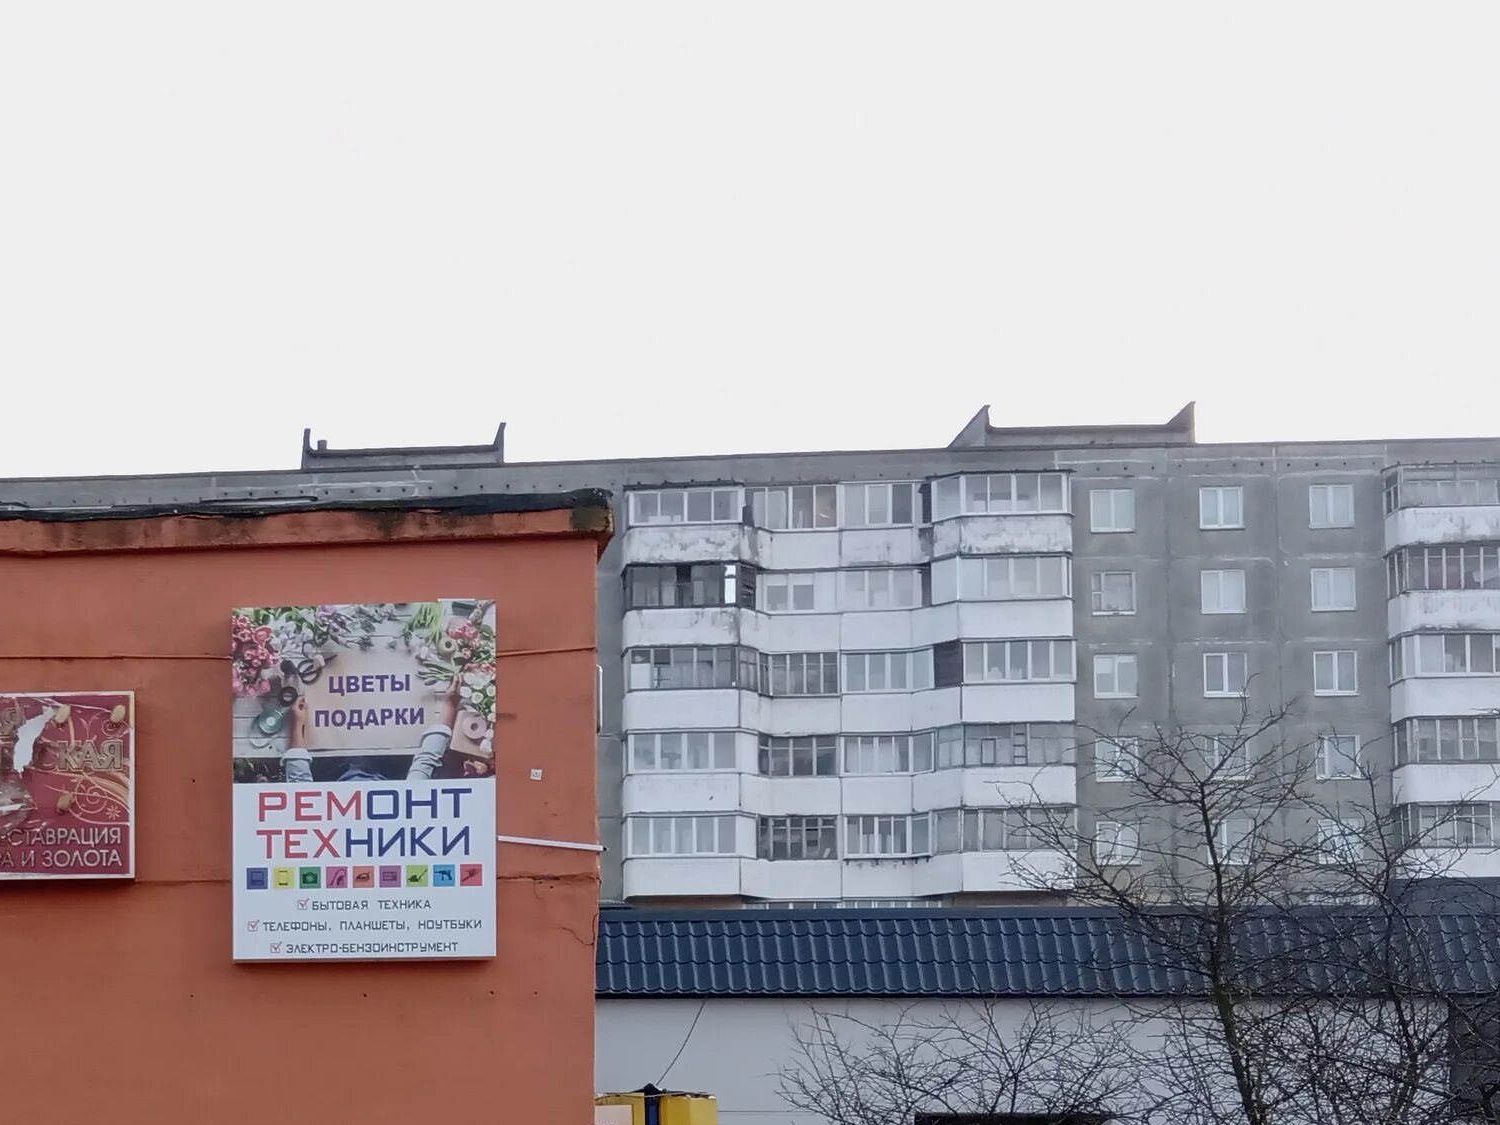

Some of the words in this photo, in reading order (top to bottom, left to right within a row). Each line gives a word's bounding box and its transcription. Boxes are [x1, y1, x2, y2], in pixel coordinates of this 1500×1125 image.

[328, 674, 411, 696] ЦВЕТЫ
[314, 707, 425, 730] ПОДАРКИ
[258, 787, 473, 823] РЕМОНТ
[256, 825, 471, 860] ТЕХНИКИ
[20, 850, 35, 868] И
[41, 849, 123, 868] ЗОЛОТА
[311, 899, 369, 911] БЫТОВАЯ
[377, 899, 432, 910] ТЕХНИКА
[339, 920, 411, 931] ПЛАНШЕТЫ,
[417, 919, 483, 930] НОУТБУКИ
[285, 941, 459, 954] ЭЛЕКТРО-БЕНЗОИНСТРУМЕНТ
